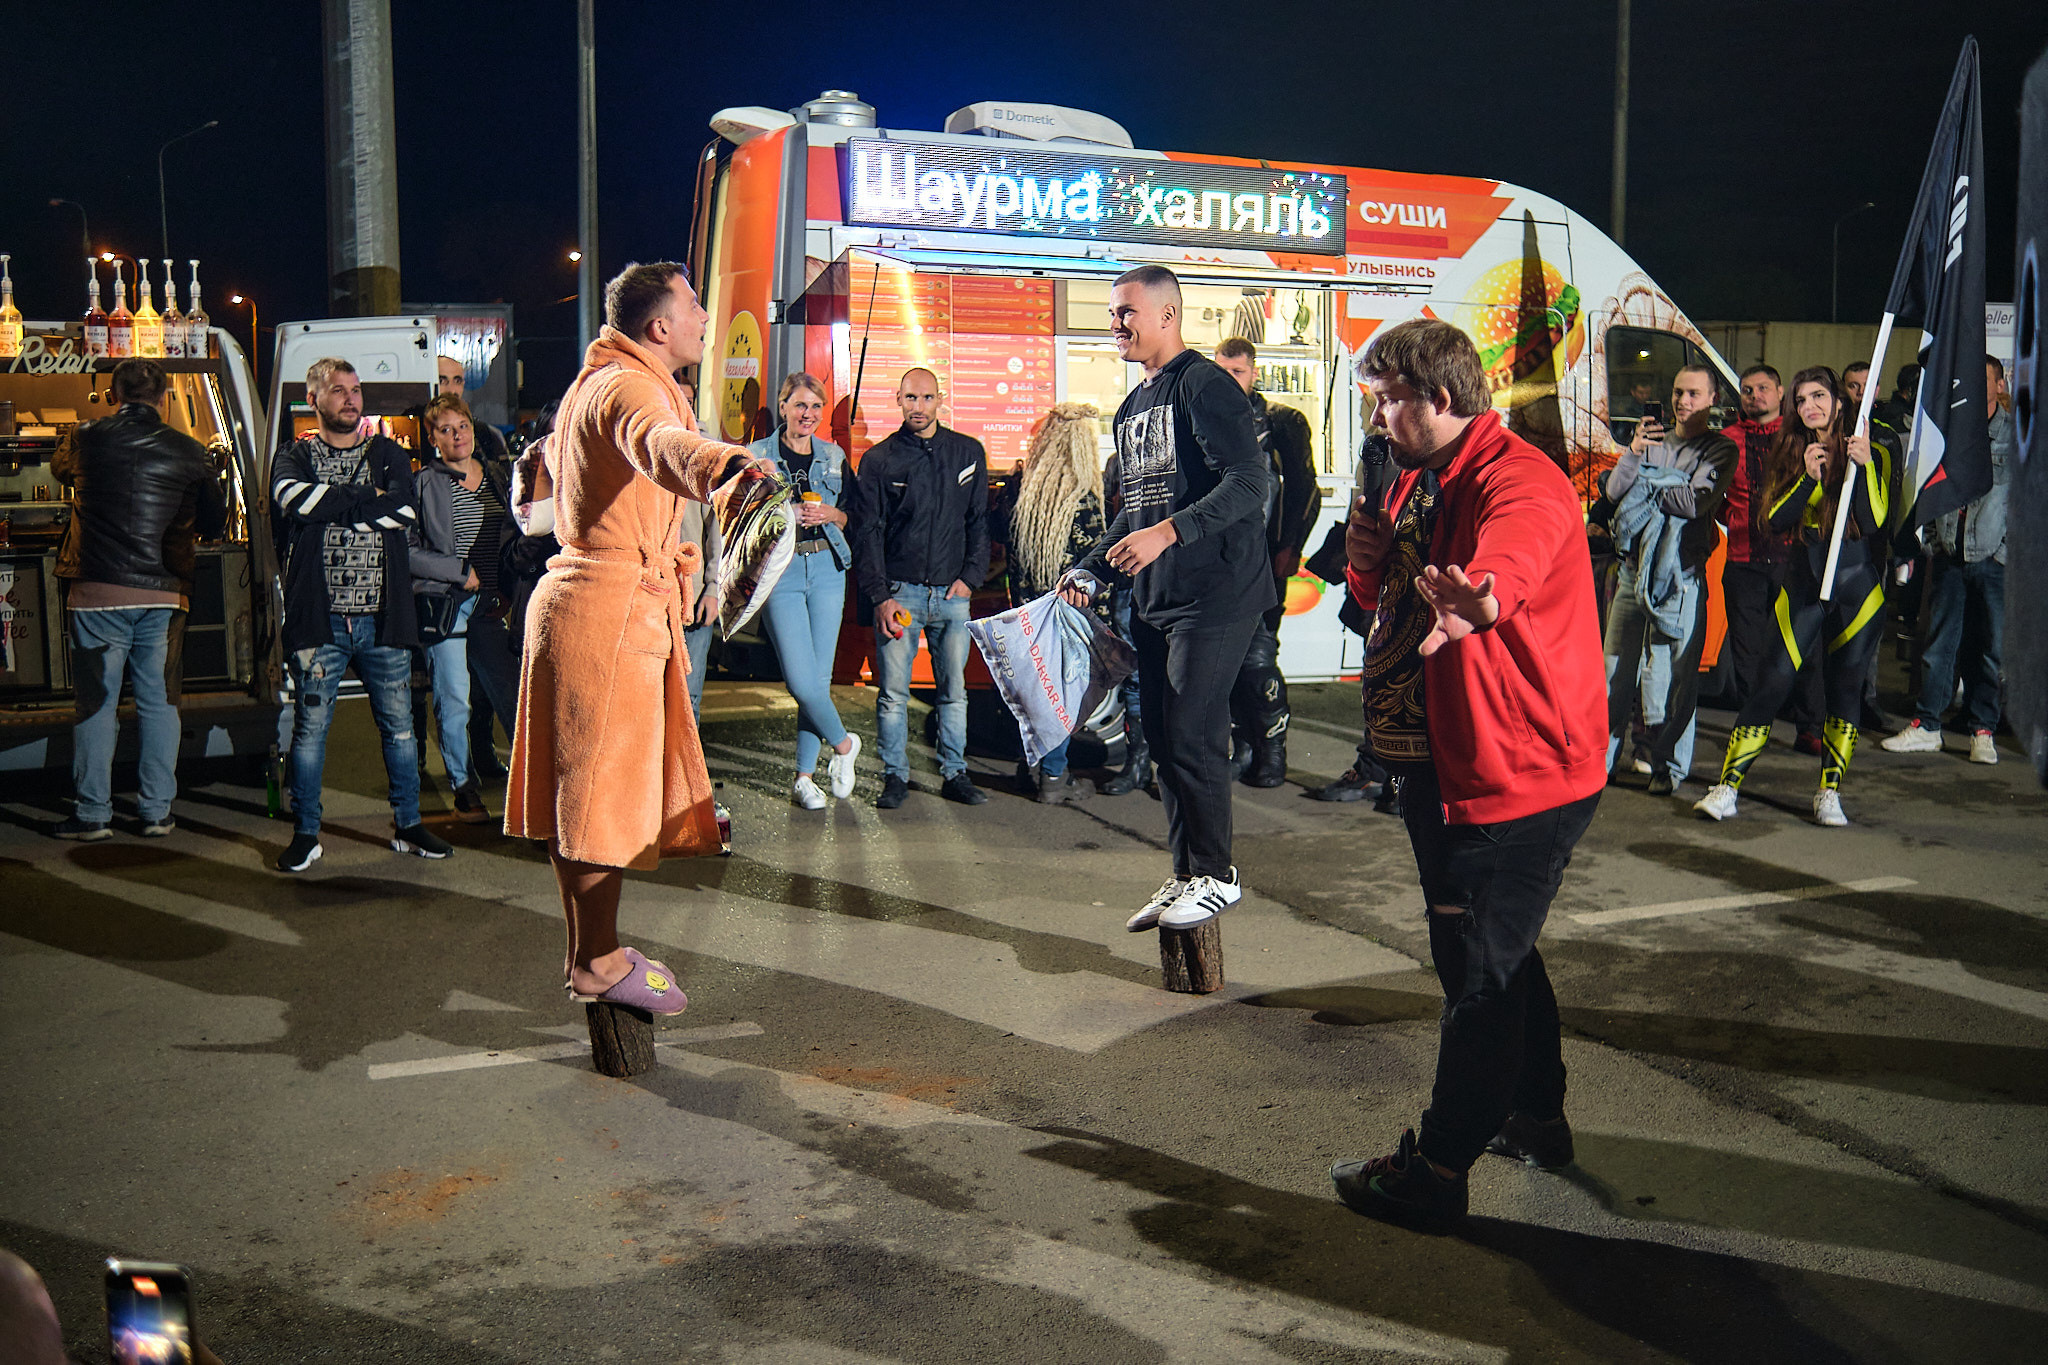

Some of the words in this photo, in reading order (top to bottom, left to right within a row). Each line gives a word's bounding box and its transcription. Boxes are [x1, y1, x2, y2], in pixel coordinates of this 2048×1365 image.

[1006, 110, 1055, 125] Dometic
[857, 151, 1100, 229] Шаурма
[1132, 185, 1331, 238] халяль
[1359, 200, 1447, 229] СУШИ
[1348, 261, 1436, 278] УЛЫБНИСЬ
[9, 336, 98, 374] Relax
[983, 424, 1022, 432] НАПИТКИ
[992, 629, 1016, 679] Jeep
